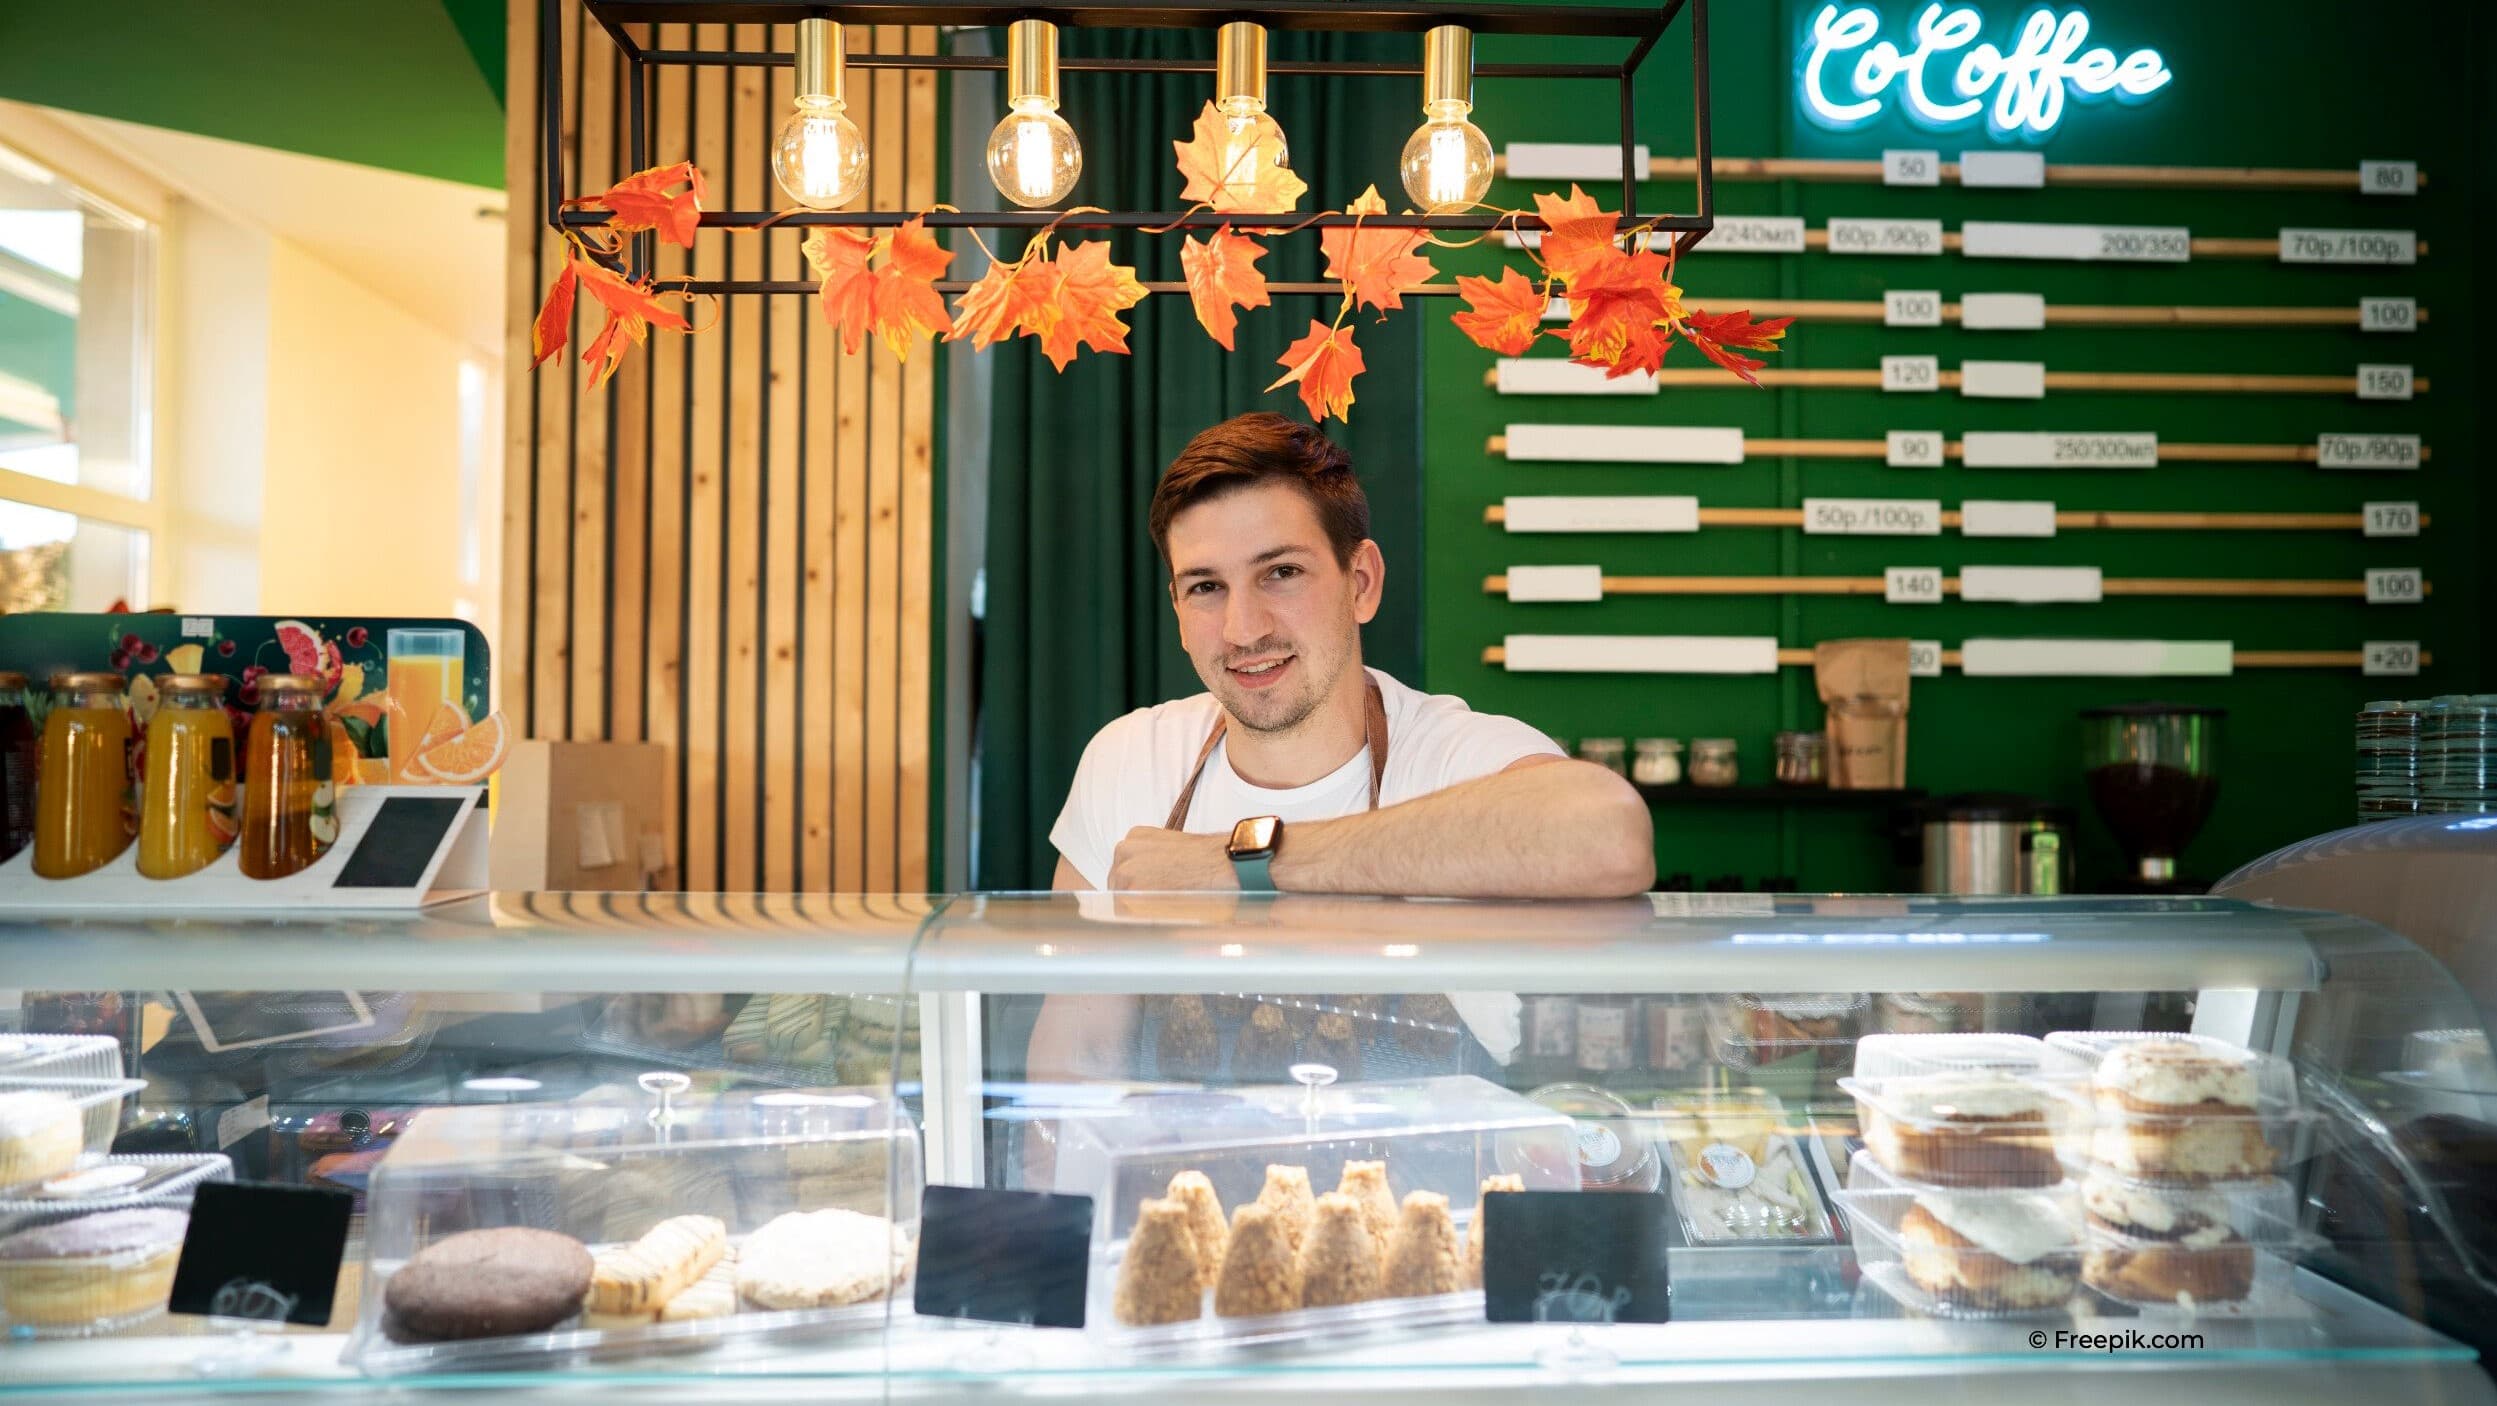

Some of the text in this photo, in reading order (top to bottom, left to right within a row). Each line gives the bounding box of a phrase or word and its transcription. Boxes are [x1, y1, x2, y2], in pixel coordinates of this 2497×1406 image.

[1898, 156, 1926, 177] 50
[2375, 166, 2404, 188] 80
[1894, 297, 1933, 318] 100
[2370, 303, 2410, 326] 100
[1892, 361, 1931, 384] 120
[2367, 371, 2406, 393] 150
[1901, 438, 1930, 459] 90
[2372, 509, 2413, 531] 170
[1895, 574, 1936, 597] 140
[2375, 575, 2415, 597] 100
[2373, 646, 2412, 670] +20
